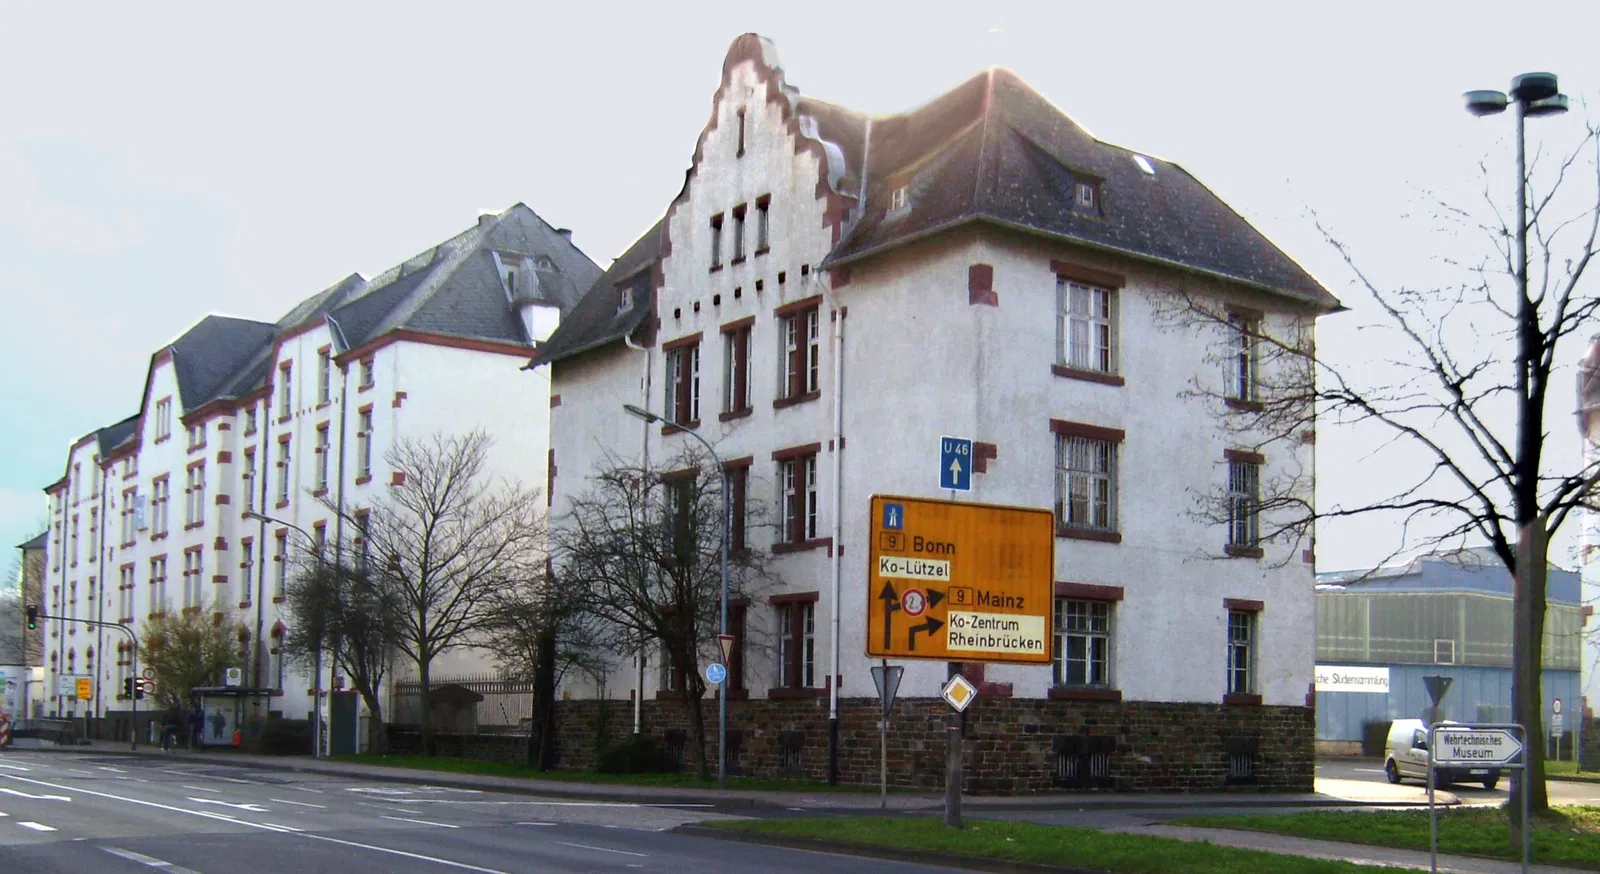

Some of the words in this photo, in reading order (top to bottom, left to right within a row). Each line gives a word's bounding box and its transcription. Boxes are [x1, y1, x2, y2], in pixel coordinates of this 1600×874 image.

[944, 441, 952, 453] U
[955, 443, 969, 455] 46
[888, 535, 897, 548] 9
[913, 536, 956, 554] Bonn
[880, 559, 948, 576] Ko-Lützel
[957, 589, 965, 602] 9
[977, 591, 1025, 609] Mainz
[950, 614, 1019, 631] Ko-Zentrum
[949, 632, 1042, 649] Rheinbrücken
[1443, 733, 1503, 746] Wehrtechnisches
[1452, 747, 1494, 758] Museum
